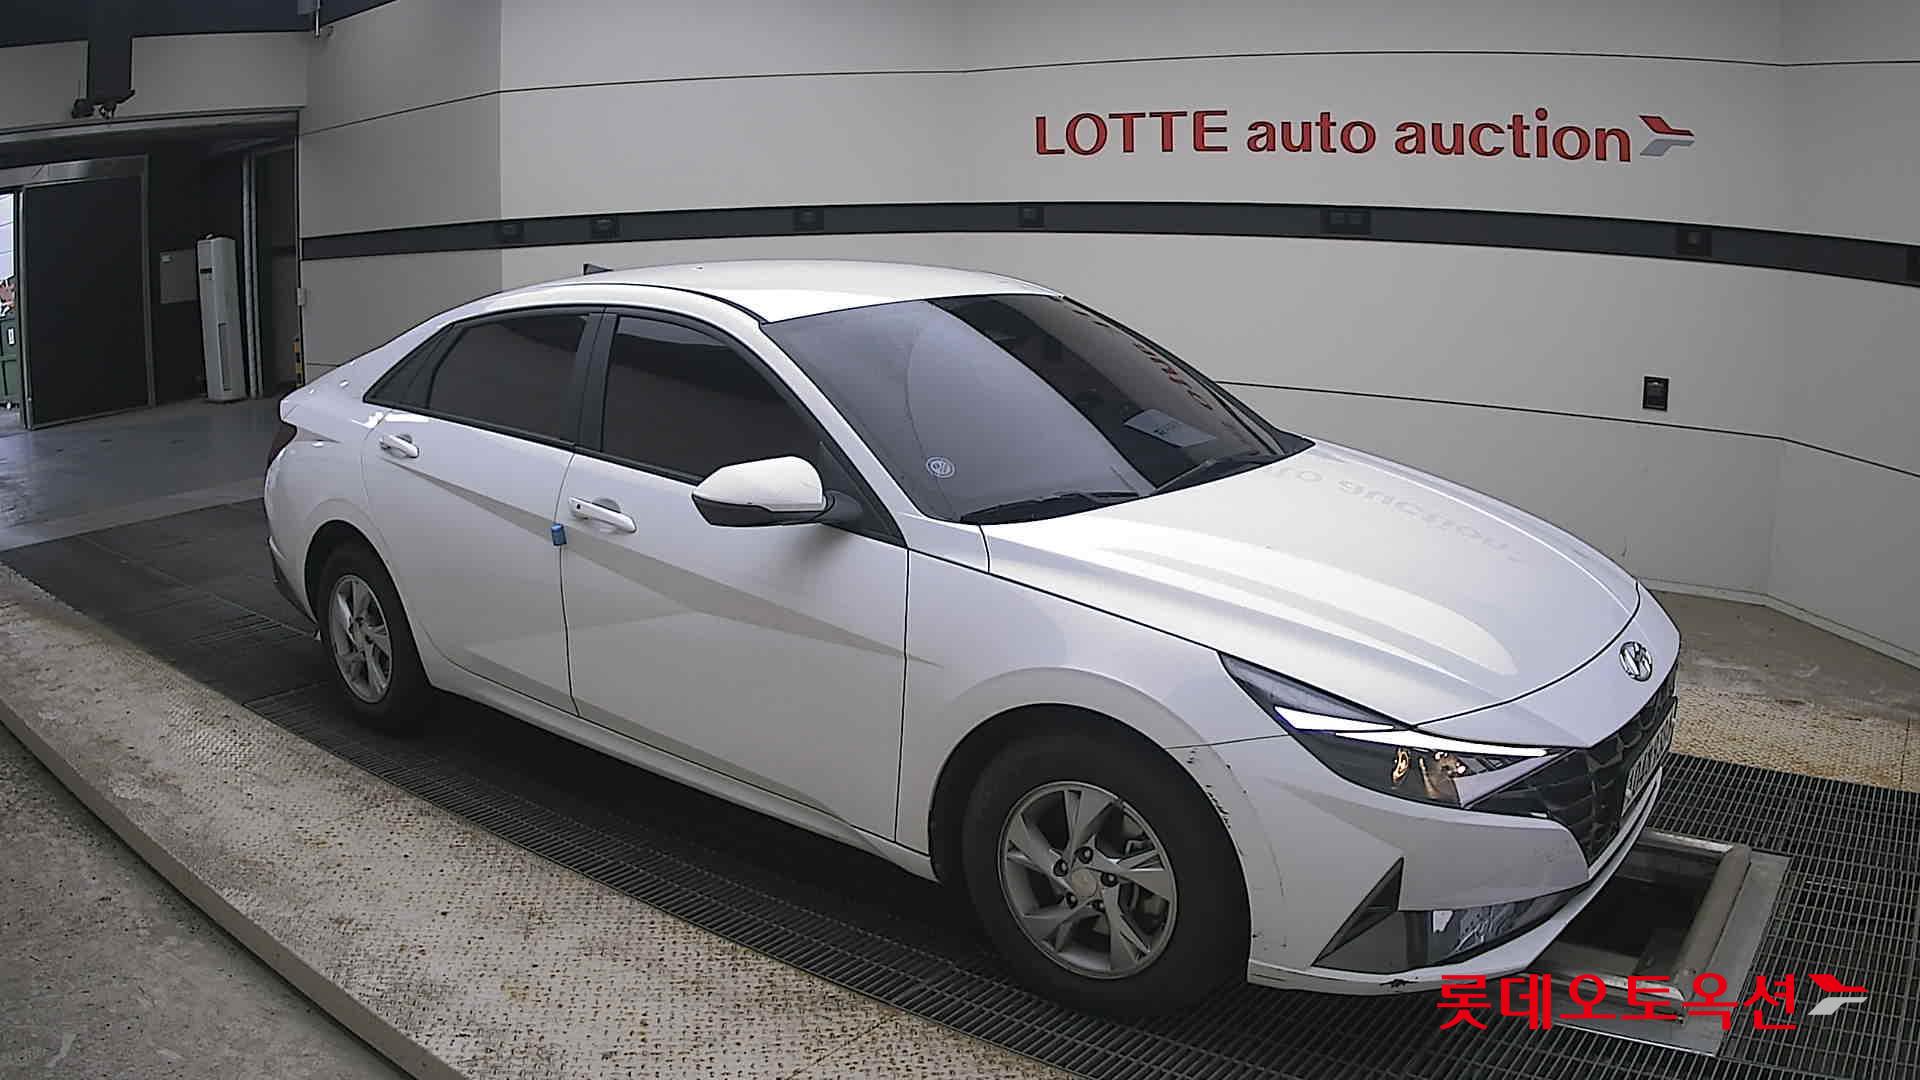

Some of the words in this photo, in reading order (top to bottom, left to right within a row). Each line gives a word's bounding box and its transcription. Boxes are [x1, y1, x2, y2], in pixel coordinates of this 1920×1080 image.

[1036, 110, 1228, 156] LOTTE
[1247, 111, 1377, 155] auto
[1394, 107, 1632, 162] auction
